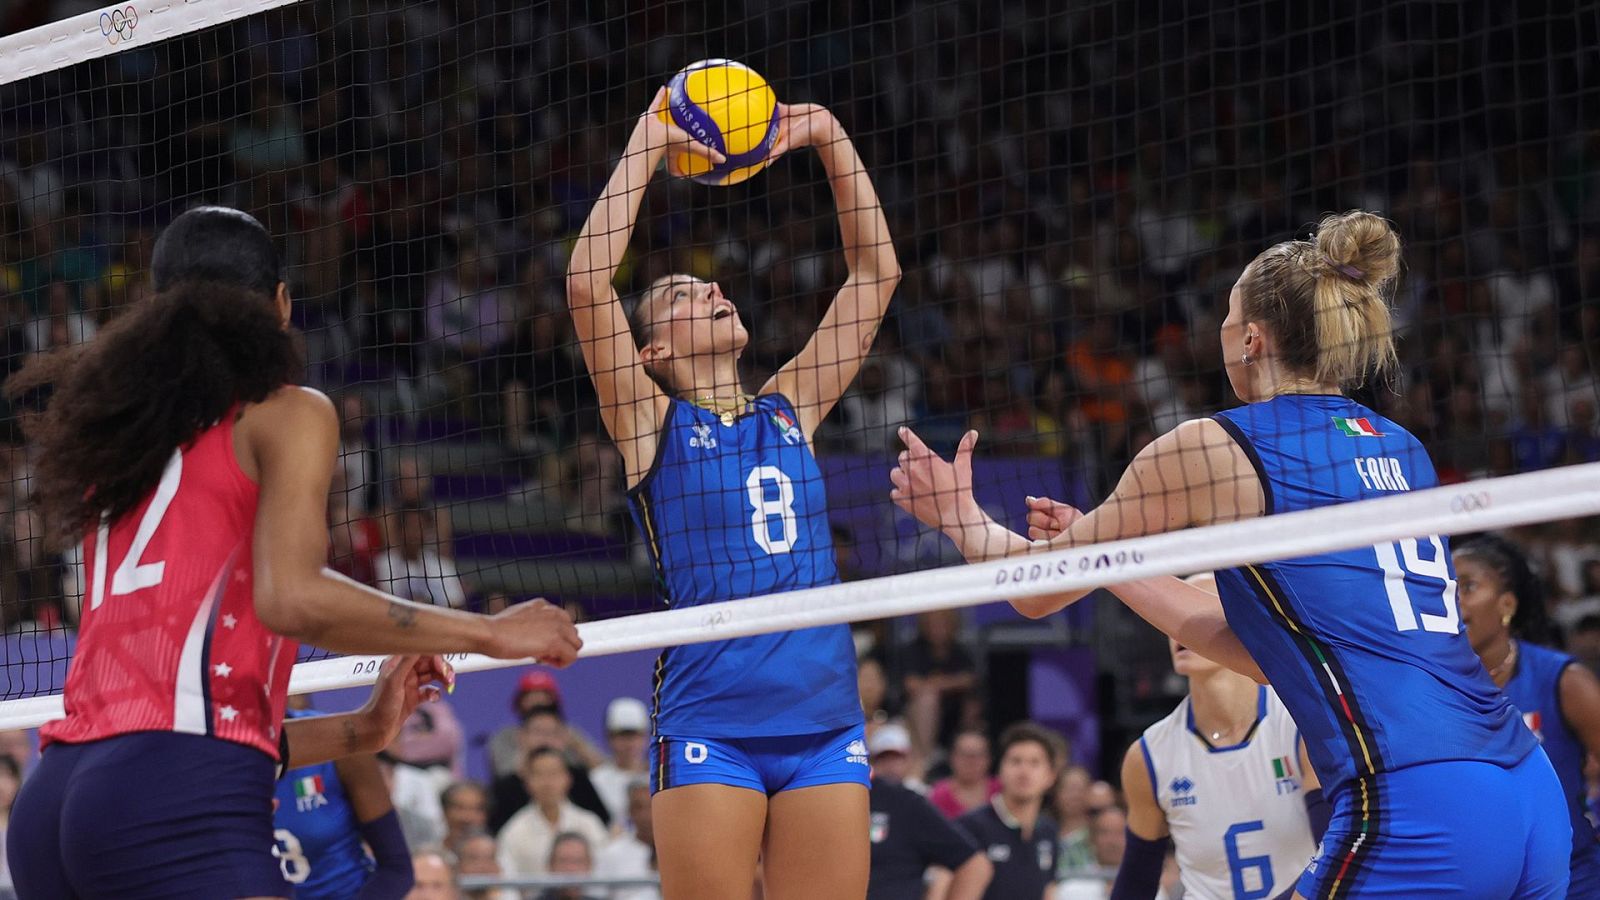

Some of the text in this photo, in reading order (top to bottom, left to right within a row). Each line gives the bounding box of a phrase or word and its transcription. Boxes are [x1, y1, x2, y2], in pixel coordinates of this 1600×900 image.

[746, 465, 798, 554] 8
[1354, 457, 1410, 491] FAHR
[1373, 533, 1460, 634] 19
[296, 794, 328, 812] ITA
[1223, 819, 1275, 900] 6
